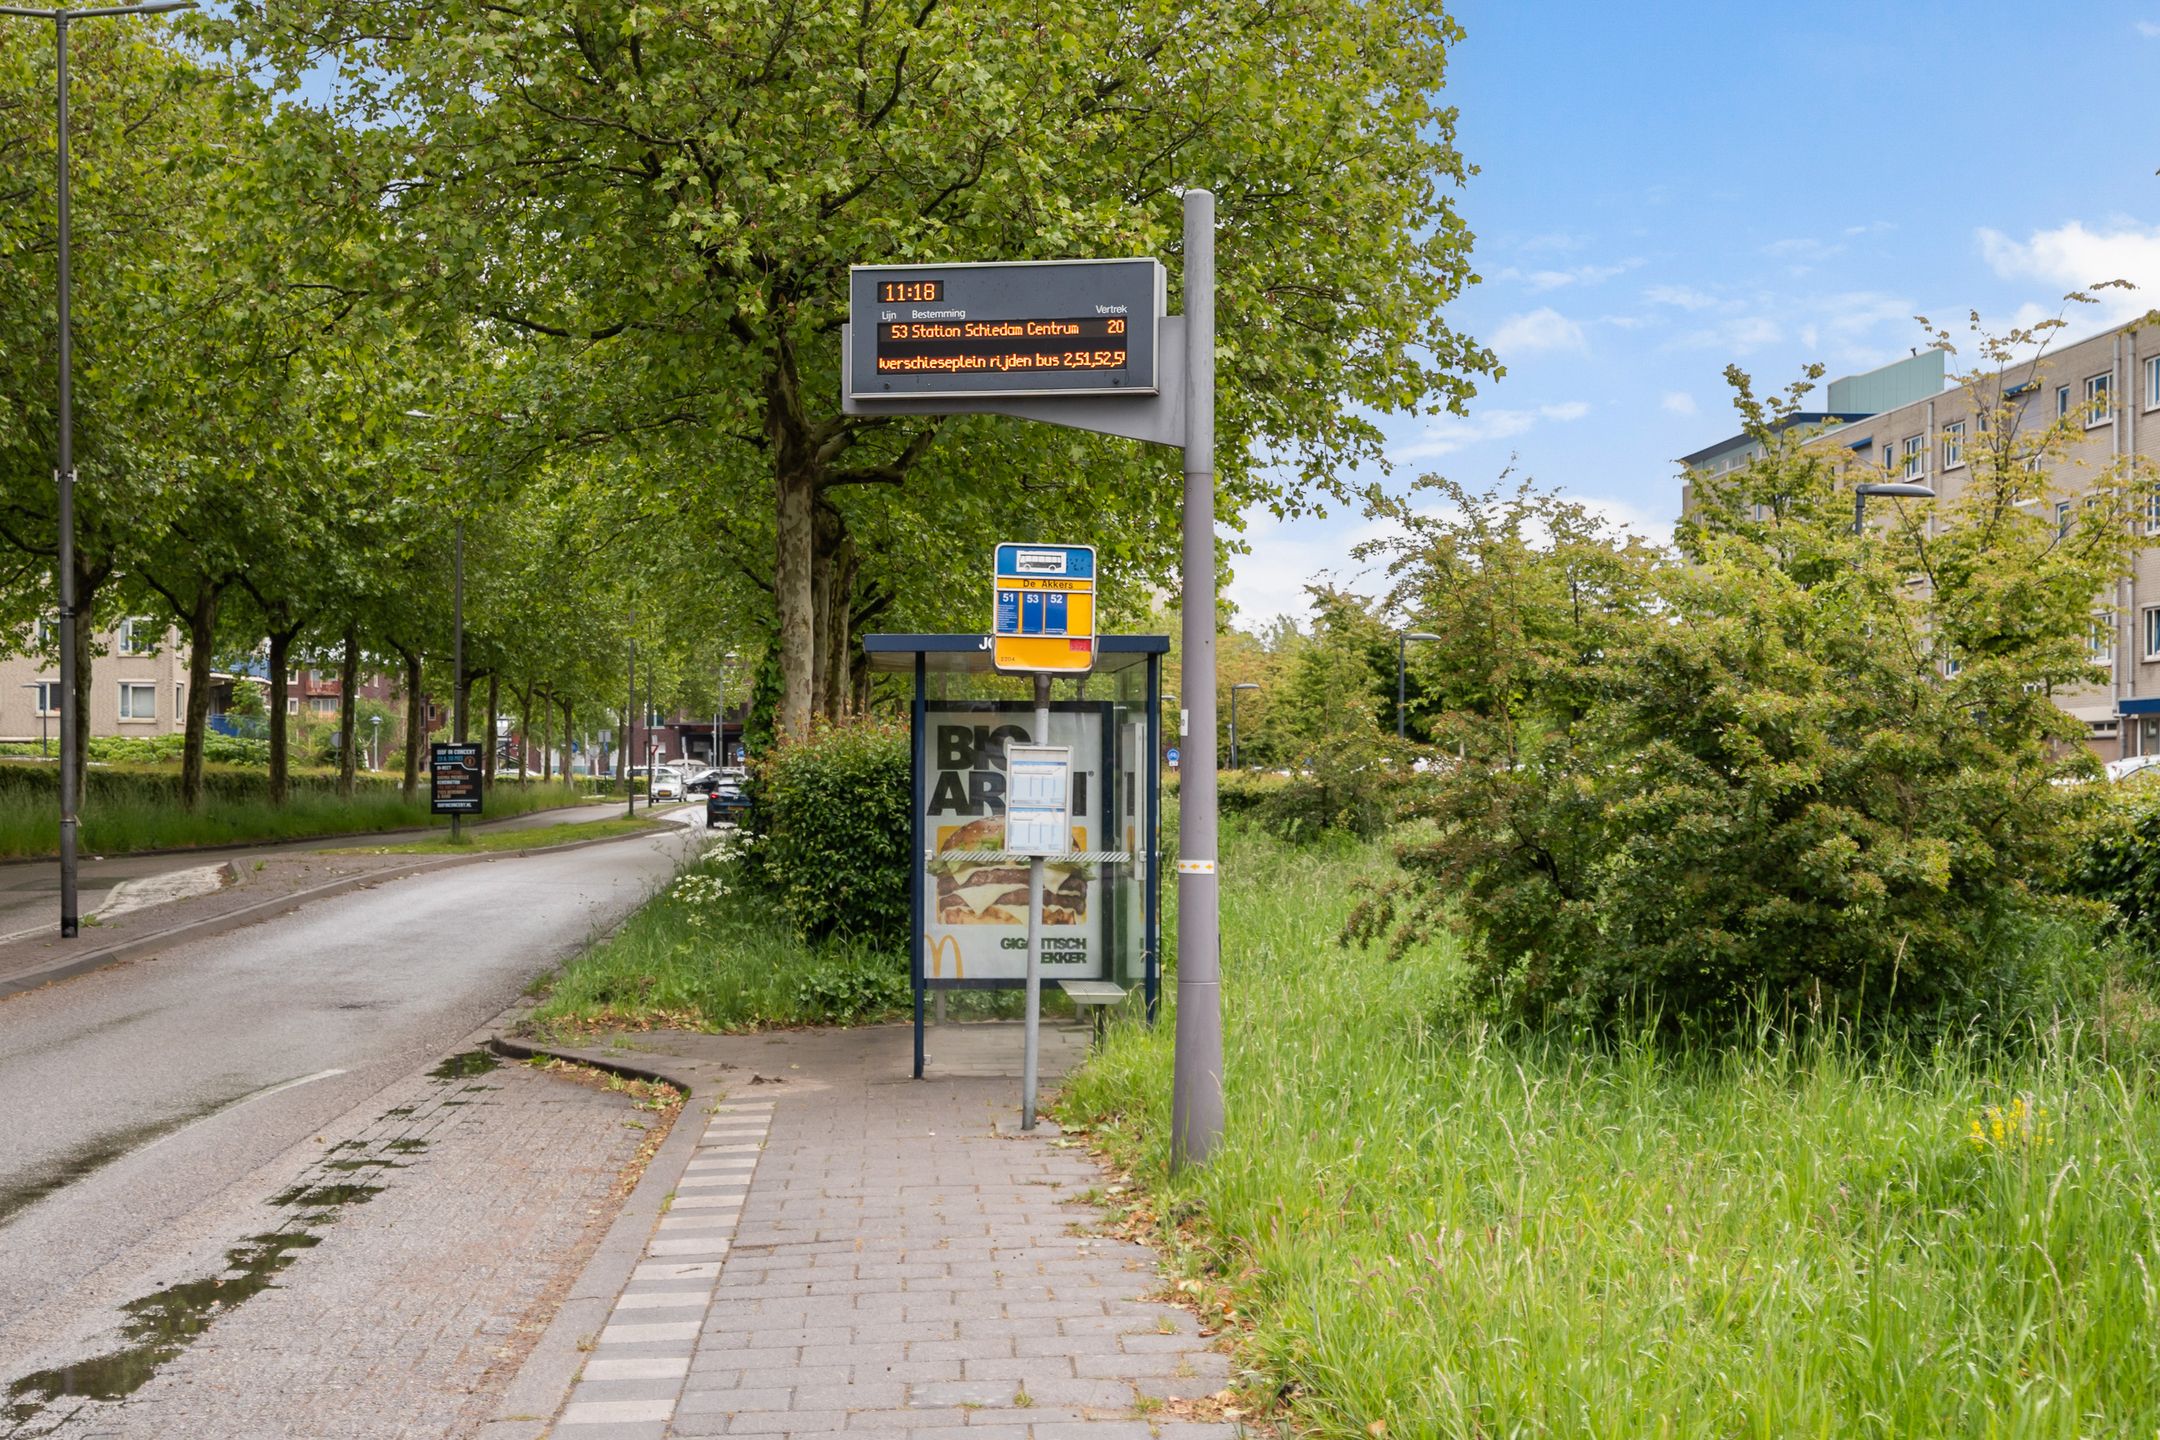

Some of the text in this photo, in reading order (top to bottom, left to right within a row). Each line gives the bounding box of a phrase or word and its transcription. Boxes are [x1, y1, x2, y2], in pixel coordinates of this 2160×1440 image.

[886, 283, 935, 302] 11:18
[1095, 304, 1128, 314] Vertrek
[881, 308, 966, 322] Lijn Bestemming
[891, 319, 1125, 340] 53 Station Schiedam Centrum 20
[1036, 352, 1060, 367] bus
[1023, 579, 1074, 589] De Akkers
[1002, 593, 1014, 603] 51
[1026, 594, 1039, 604] 53
[1050, 594, 1063, 604] 52
[1040, 952, 1087, 964] EKKER
